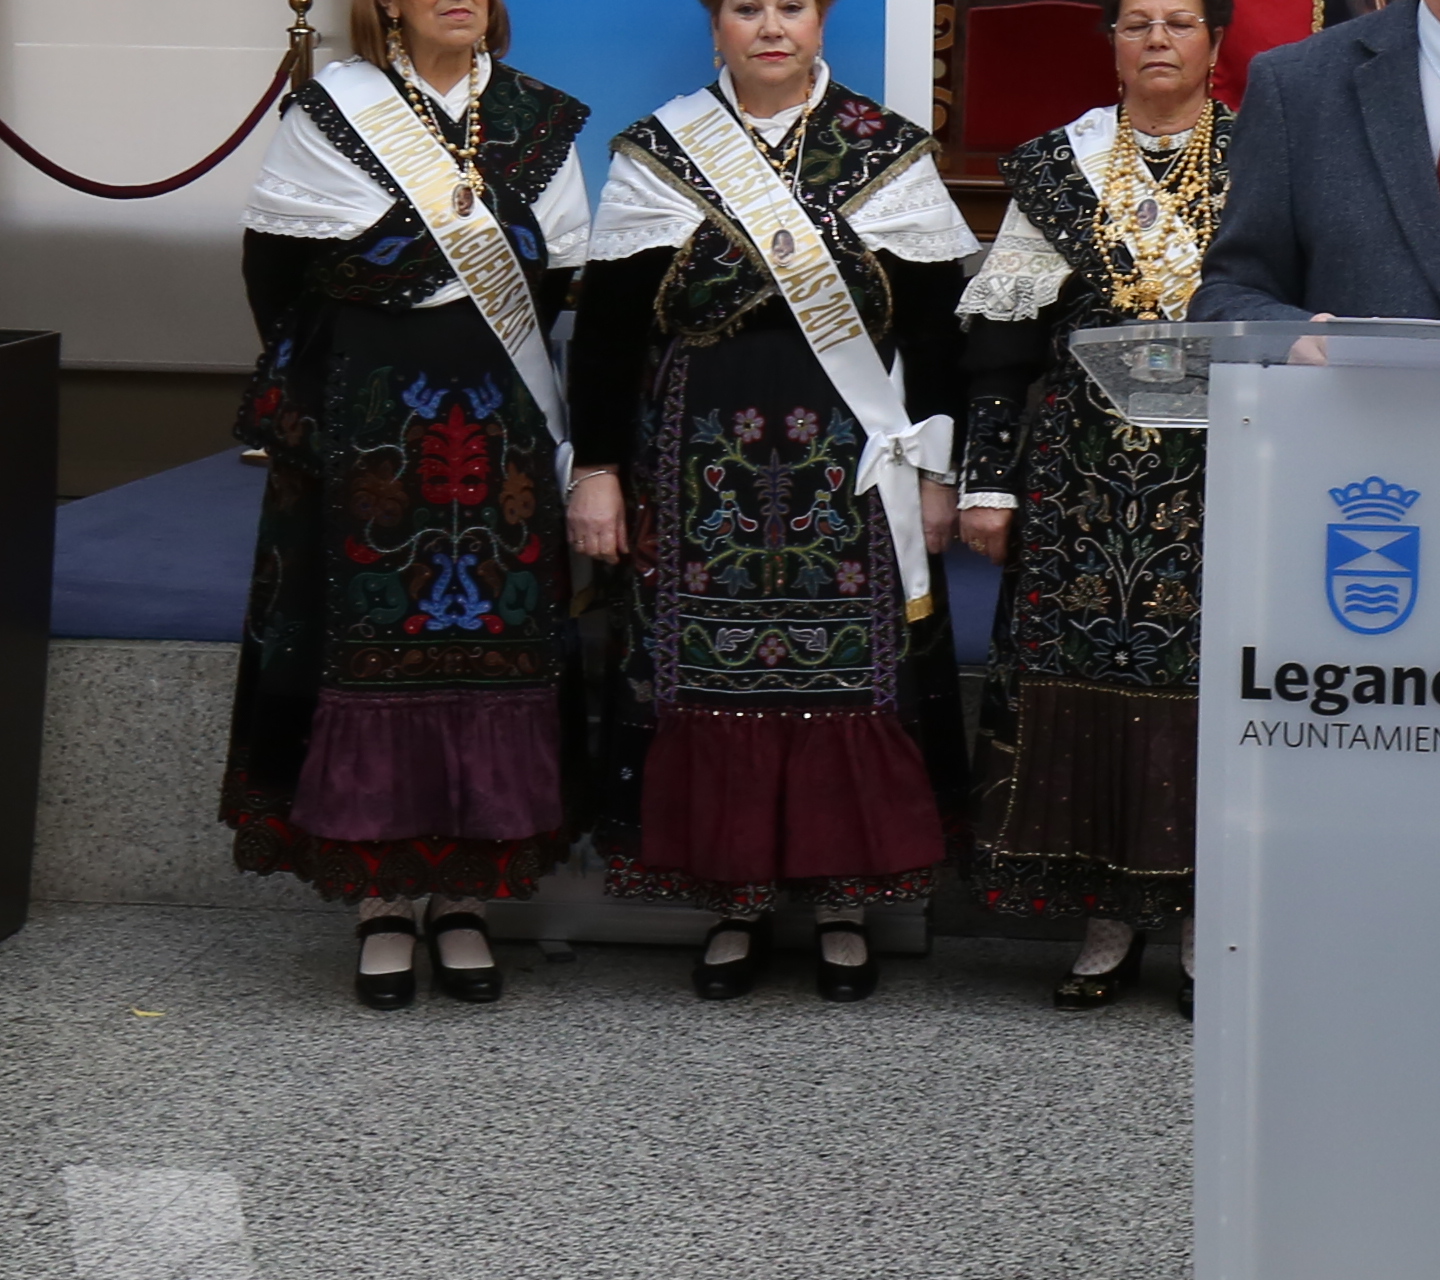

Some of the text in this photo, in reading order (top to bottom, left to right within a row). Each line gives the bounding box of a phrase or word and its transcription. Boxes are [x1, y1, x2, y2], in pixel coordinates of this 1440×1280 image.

[440, 216, 527, 317] AGUEDAS
[491, 299, 536, 358] 2017
[675, 107, 780, 211] ALCALDESA
[798, 291, 863, 354] 2017
